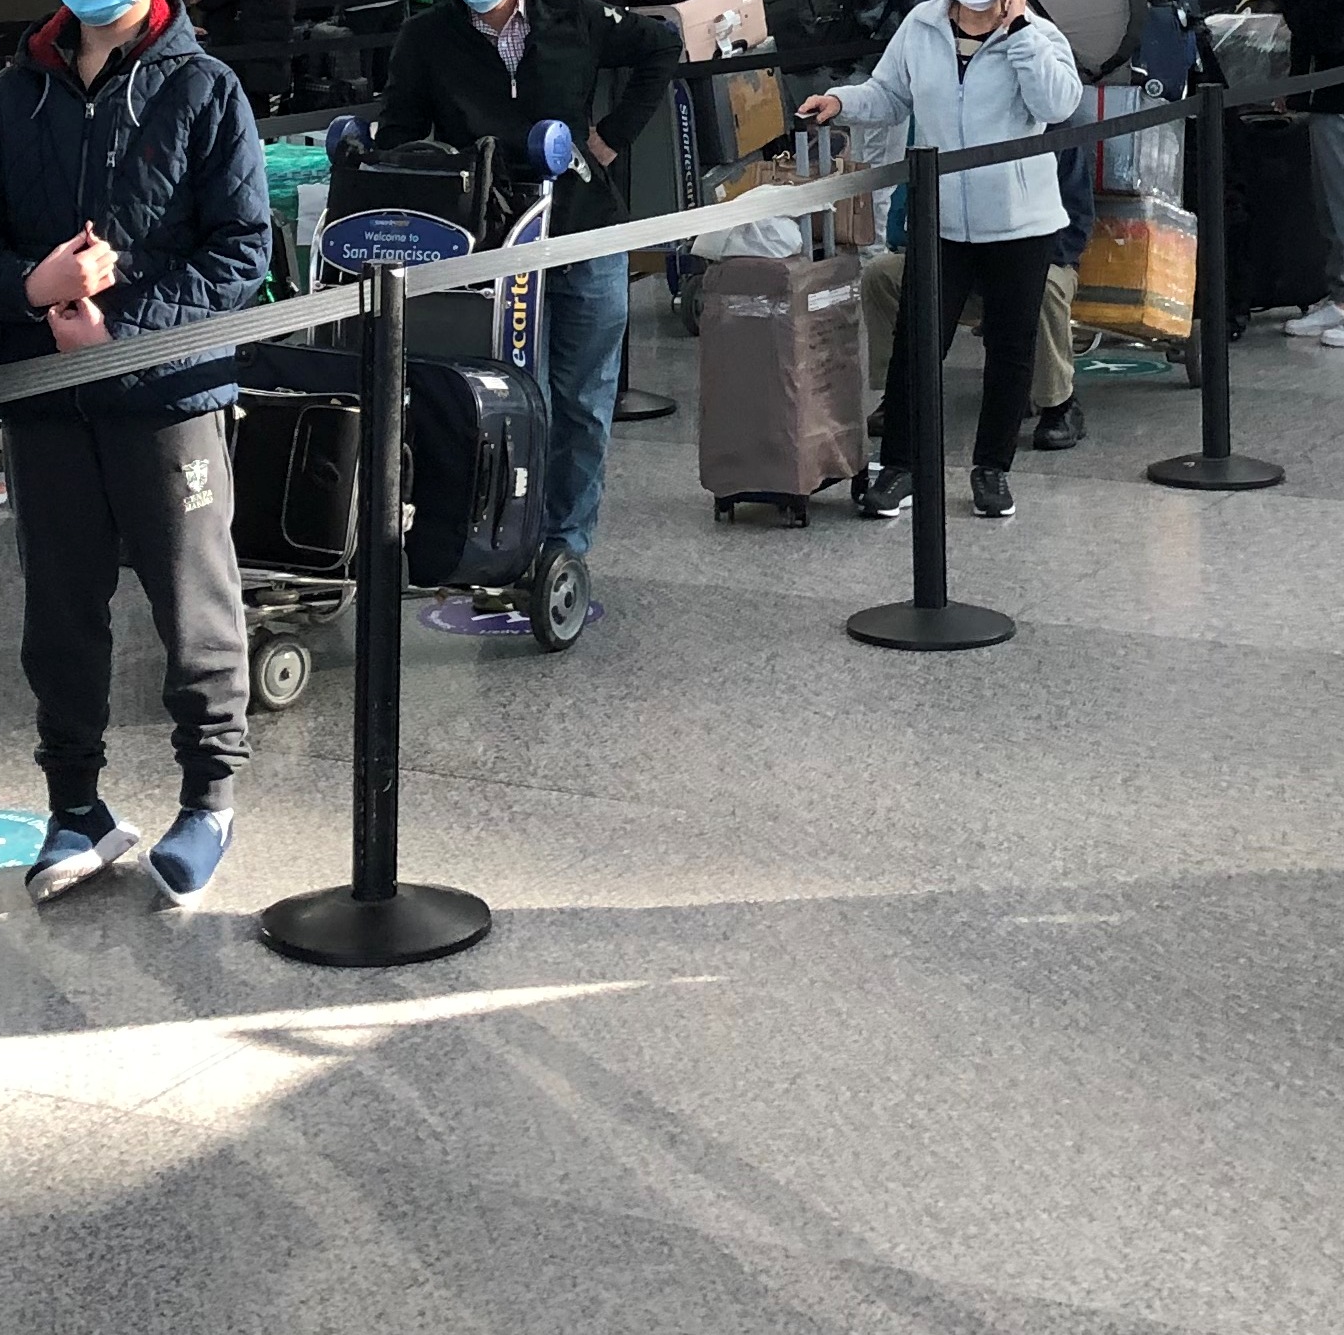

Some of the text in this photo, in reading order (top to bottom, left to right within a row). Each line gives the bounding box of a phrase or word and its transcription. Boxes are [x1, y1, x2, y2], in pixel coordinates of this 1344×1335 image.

[364, 230, 420, 243] Welcome to
[342, 243, 441, 262] San Francisco
